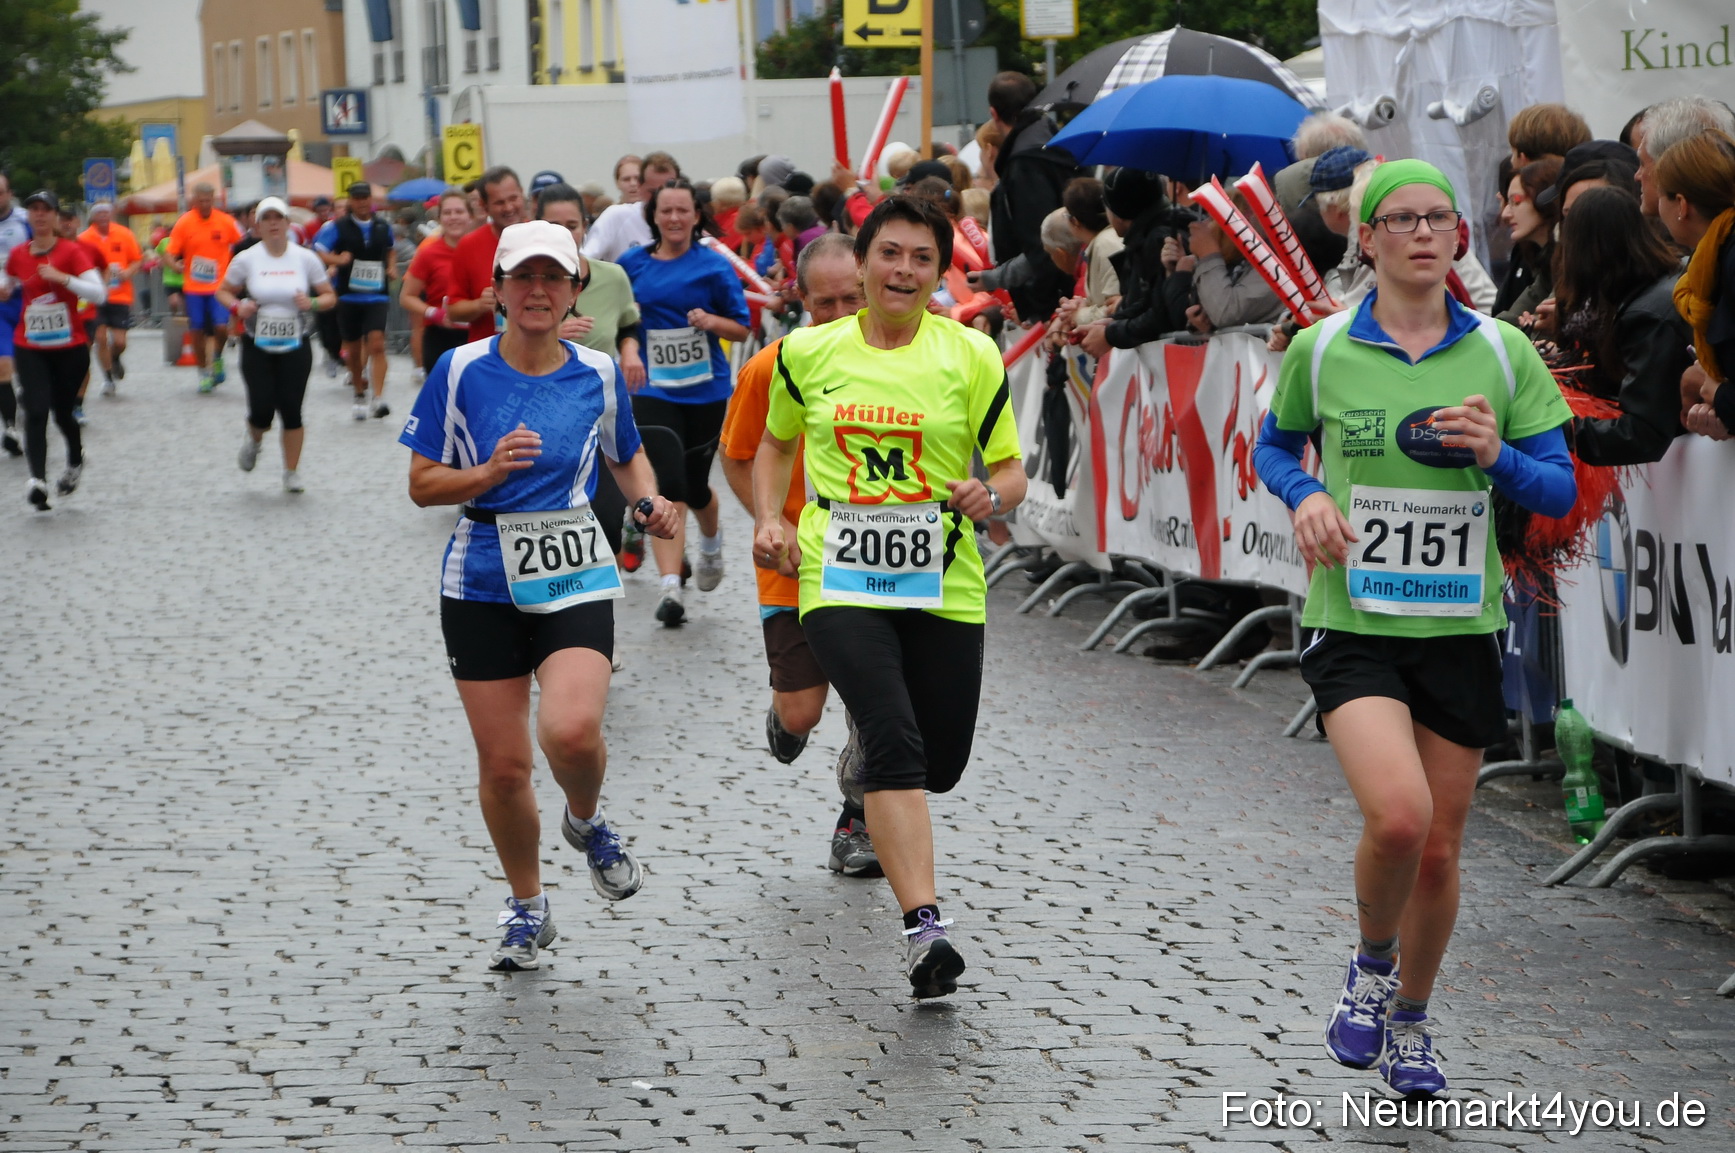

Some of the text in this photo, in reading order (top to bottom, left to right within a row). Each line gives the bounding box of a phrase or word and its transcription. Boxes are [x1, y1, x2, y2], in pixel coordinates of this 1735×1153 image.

[453, 141, 473, 171] C
[341, 171, 356, 193] D
[259, 321, 295, 336] 2693
[653, 341, 704, 365] 3055
[833, 404, 925, 426] Müller
[1342, 439, 1385, 447] Fachbetrieb
[1343, 449, 1385, 458] RICHTER
[861, 447, 910, 482] M
[831, 511, 921, 524] PARTL Neumarkt
[1353, 498, 1467, 516] PARTL Neumarkt
[500, 522, 538, 534] PARTL
[514, 526, 598, 575] 2607
[836, 528, 932, 569] 2068
[1361, 518, 1471, 567] 2151
[548, 579, 585, 597] Stilla
[866, 577, 896, 593] Rita
[1361, 576, 1469, 599] Ann-Christin
